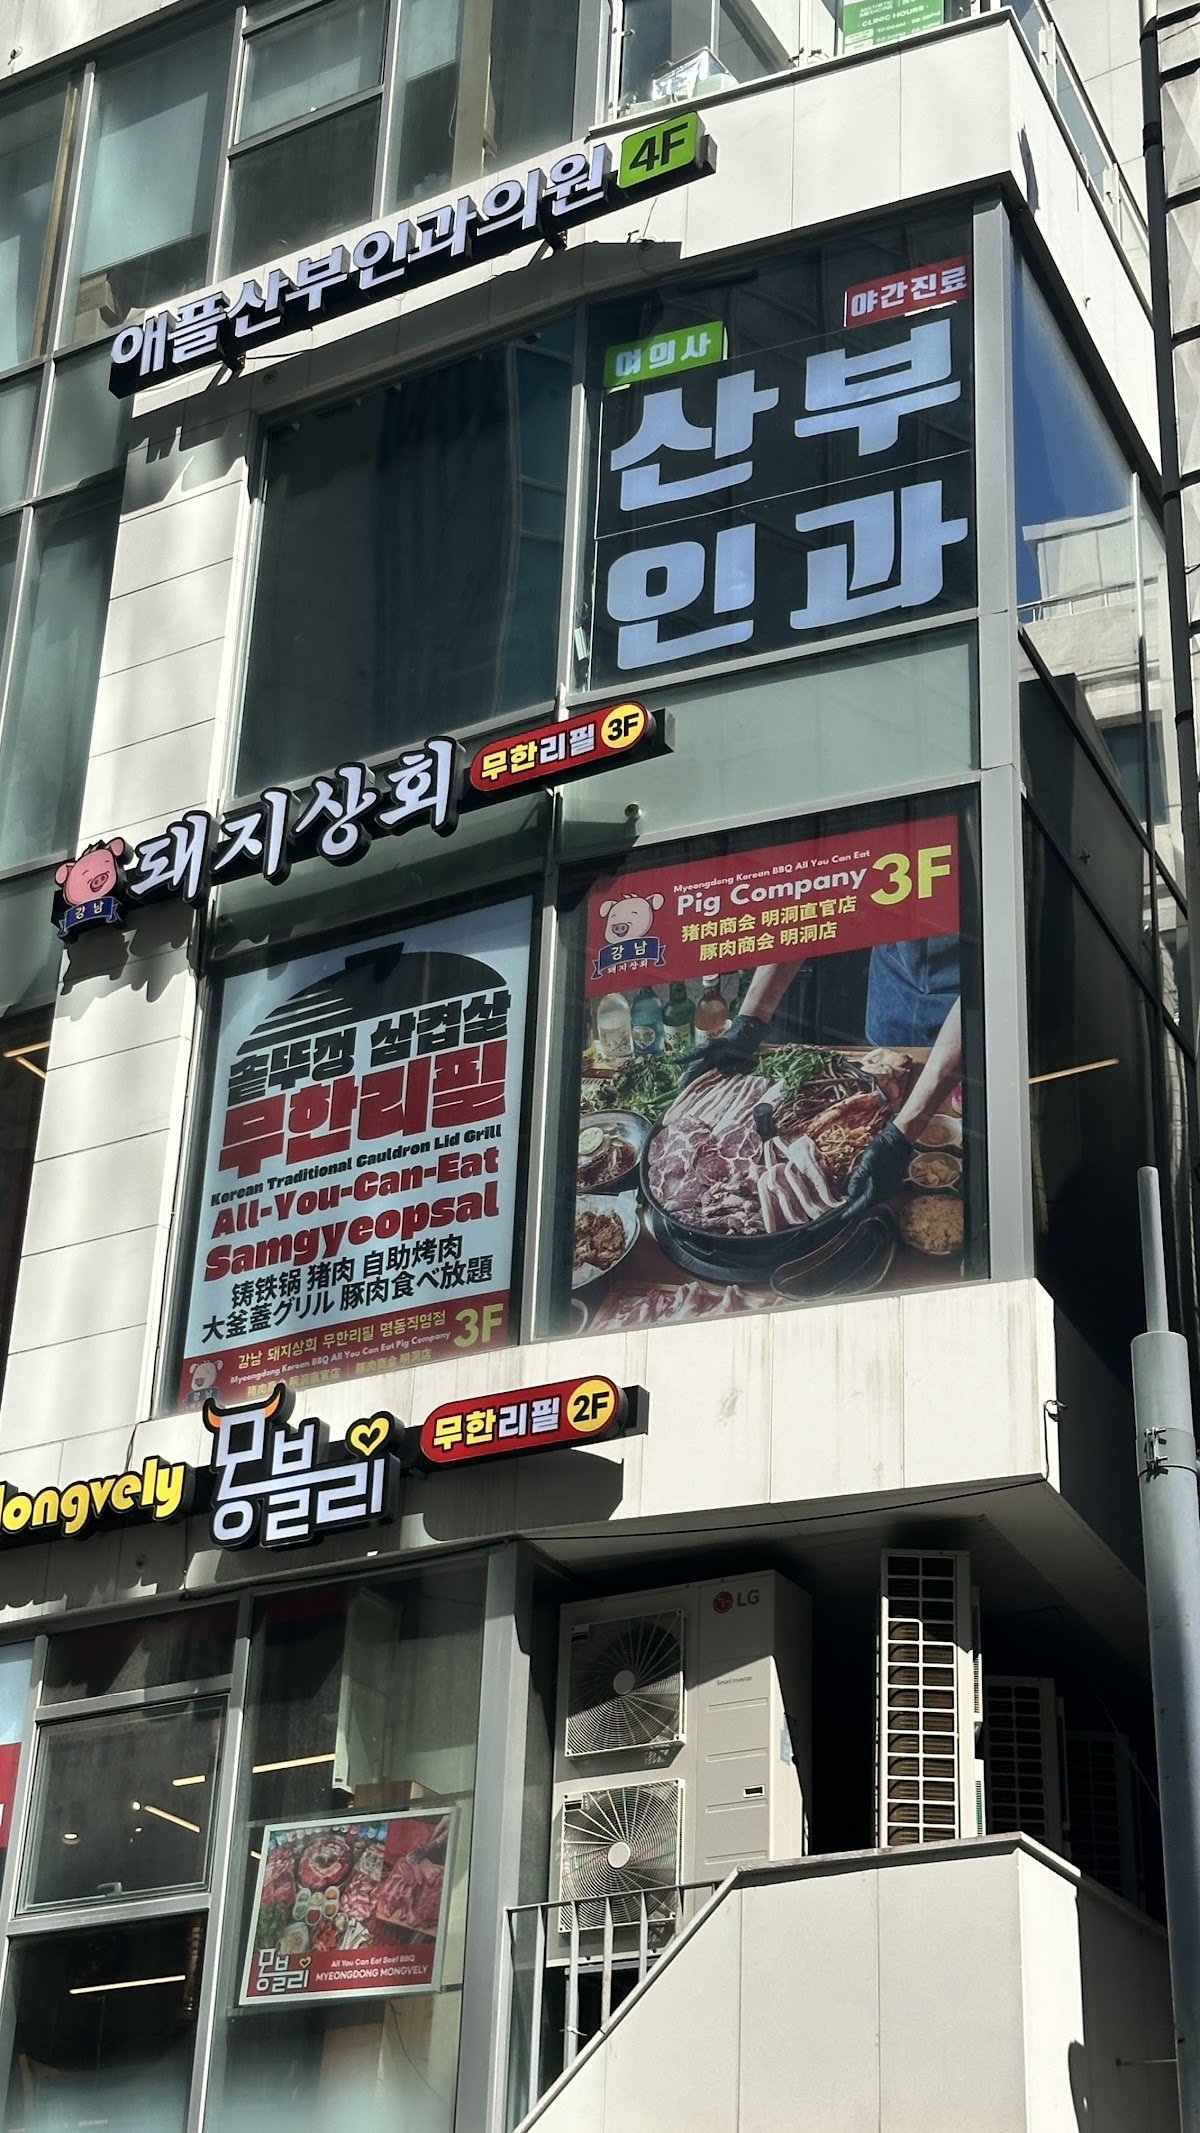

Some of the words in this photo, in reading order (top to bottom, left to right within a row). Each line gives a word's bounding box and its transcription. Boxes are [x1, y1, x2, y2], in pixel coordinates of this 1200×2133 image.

[862, 14, 891, 27] CLINIC
[893, 5, 925, 19] HOURS
[111, 144, 604, 376] 애플산부인과의원
[629, 122, 689, 172] 4F
[850, 265, 968, 317] 야간진료
[616, 331, 711, 377] 여의사
[131, 740, 456, 898] 돼지상회
[482, 723, 594, 780] 무한리필
[607, 712, 639, 741] 3F
[673, 876, 734, 893] Myeongdong
[736, 870, 770, 882] Korean
[772, 864, 793, 875] BBQ
[795, 860, 808, 870] All
[811, 858, 829, 867] You
[831, 854, 851, 863] Can
[853, 850, 870, 859] Eat
[677, 892, 720, 916] Pig
[730, 868, 867, 905] Company
[870, 845, 952, 905] 3F
[611, 940, 648, 960] 강남
[681, 914, 756, 943] 猪肉商会
[699, 932, 775, 961] 豚肉商会
[780, 922, 838, 946] 明洞店
[227, 1026, 357, 1107] 솥뚜껑
[370, 990, 512, 1067] 삼겹살
[218, 1039, 508, 1179] 무한리필
[210, 1182, 263, 1206] Korean
[267, 1157, 352, 1190] Traditional
[356, 1141, 430, 1167] Cauldron
[434, 1132, 460, 1150] Lid
[464, 1124, 501, 1143] Grill
[211, 1146, 499, 1239] All-You-Can-Eat
[204, 1181, 499, 1282] Samgyeopsal
[231, 1268, 301, 1309] 铸铁锅
[307, 1256, 355, 1291] 猪肉
[363, 1233, 463, 1278] 自助烤肉
[340, 1254, 494, 1311] 豚肉食べ放題
[238, 1350, 263, 1369] 강남
[267, 1337, 317, 1361] 돼지상회
[322, 1324, 375, 1349] 무한리필
[380, 1309, 446, 1338] 명동직영점
[453, 1303, 504, 1347] 3F
[230, 1367, 280, 1384] Myeongdong
[281, 1361, 310, 1373] Korean
[312, 1355, 329, 1366] BBQ
[330, 1352, 343, 1362] All
[344, 1350, 360, 1359] You
[362, 1346, 379, 1355] Can
[381, 1342, 395, 1352] Eat
[396, 1339, 409, 1350] Pig
[411, 1332, 451, 1346] Company
[433, 1397, 560, 1452] 무한리필
[573, 1390, 611, 1421] 2F
[0, 1458, 185, 1534] ongvely
[213, 1409, 384, 1541] 몽블리
[737, 1589, 760, 1607] LG
[256, 1948, 311, 1992] 몽블리
[315, 1968, 379, 1981] MYEONGDONG
[380, 1964, 429, 1978] MONGVELY
[331, 1959, 341, 1968] All
[342, 1958, 354, 1967] You
[355, 1957, 370, 1966] Can
[370, 1957, 382, 1965] Eat
[399, 1954, 416, 1963] BBQ
